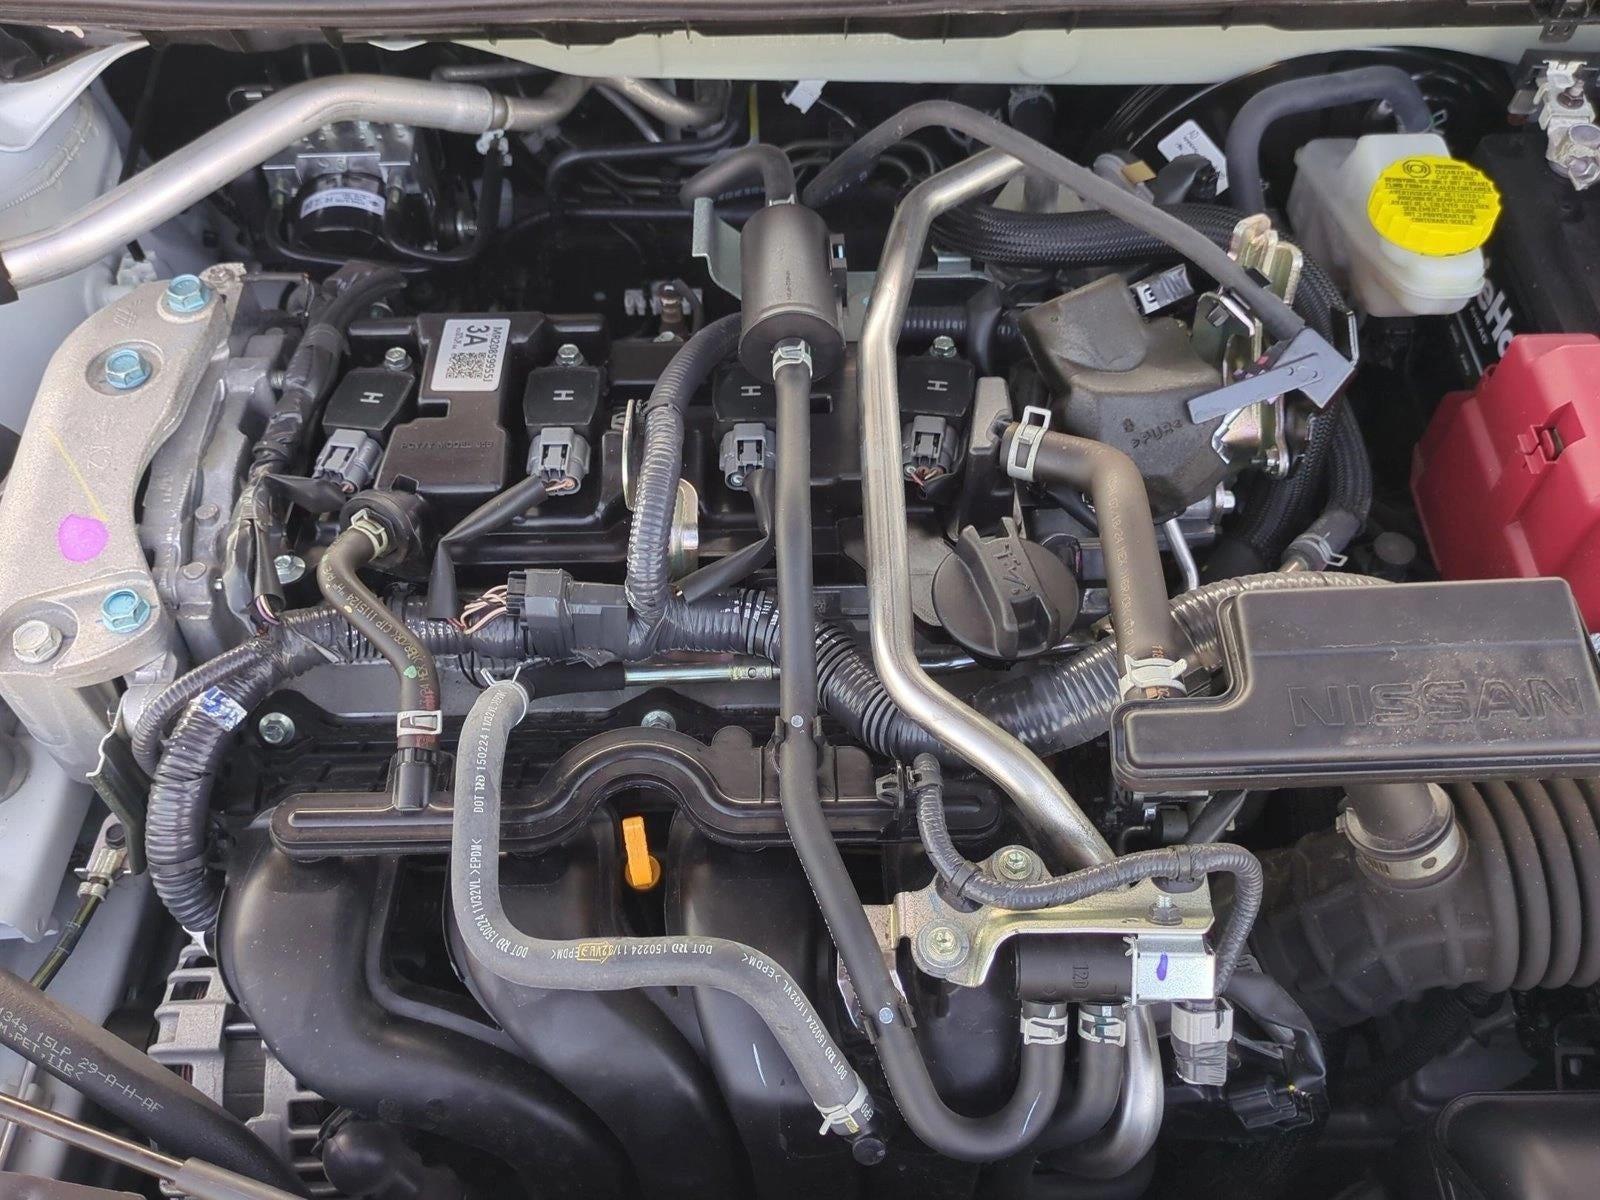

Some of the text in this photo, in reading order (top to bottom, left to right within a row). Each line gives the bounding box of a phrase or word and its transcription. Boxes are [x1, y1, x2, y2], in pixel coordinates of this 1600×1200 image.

[463, 325, 490, 347] 3A
[553, 390, 574, 400] H
[741, 386, 761, 396] H
[926, 380, 948, 391] H
[360, 392, 384, 404] H
[1288, 677, 1586, 727] NISSAN
[477, 734, 489, 771] 150224
[473, 794, 485, 813] DOT
[474, 913, 499, 943] 150224
[510, 944, 529, 958] DOT
[631, 943, 667, 955] 150224
[691, 944, 713, 955] DOT
[805, 1014, 828, 1047] 150224
[37, 1032, 72, 1056] 15LP
[833, 1060, 848, 1081] DOT
